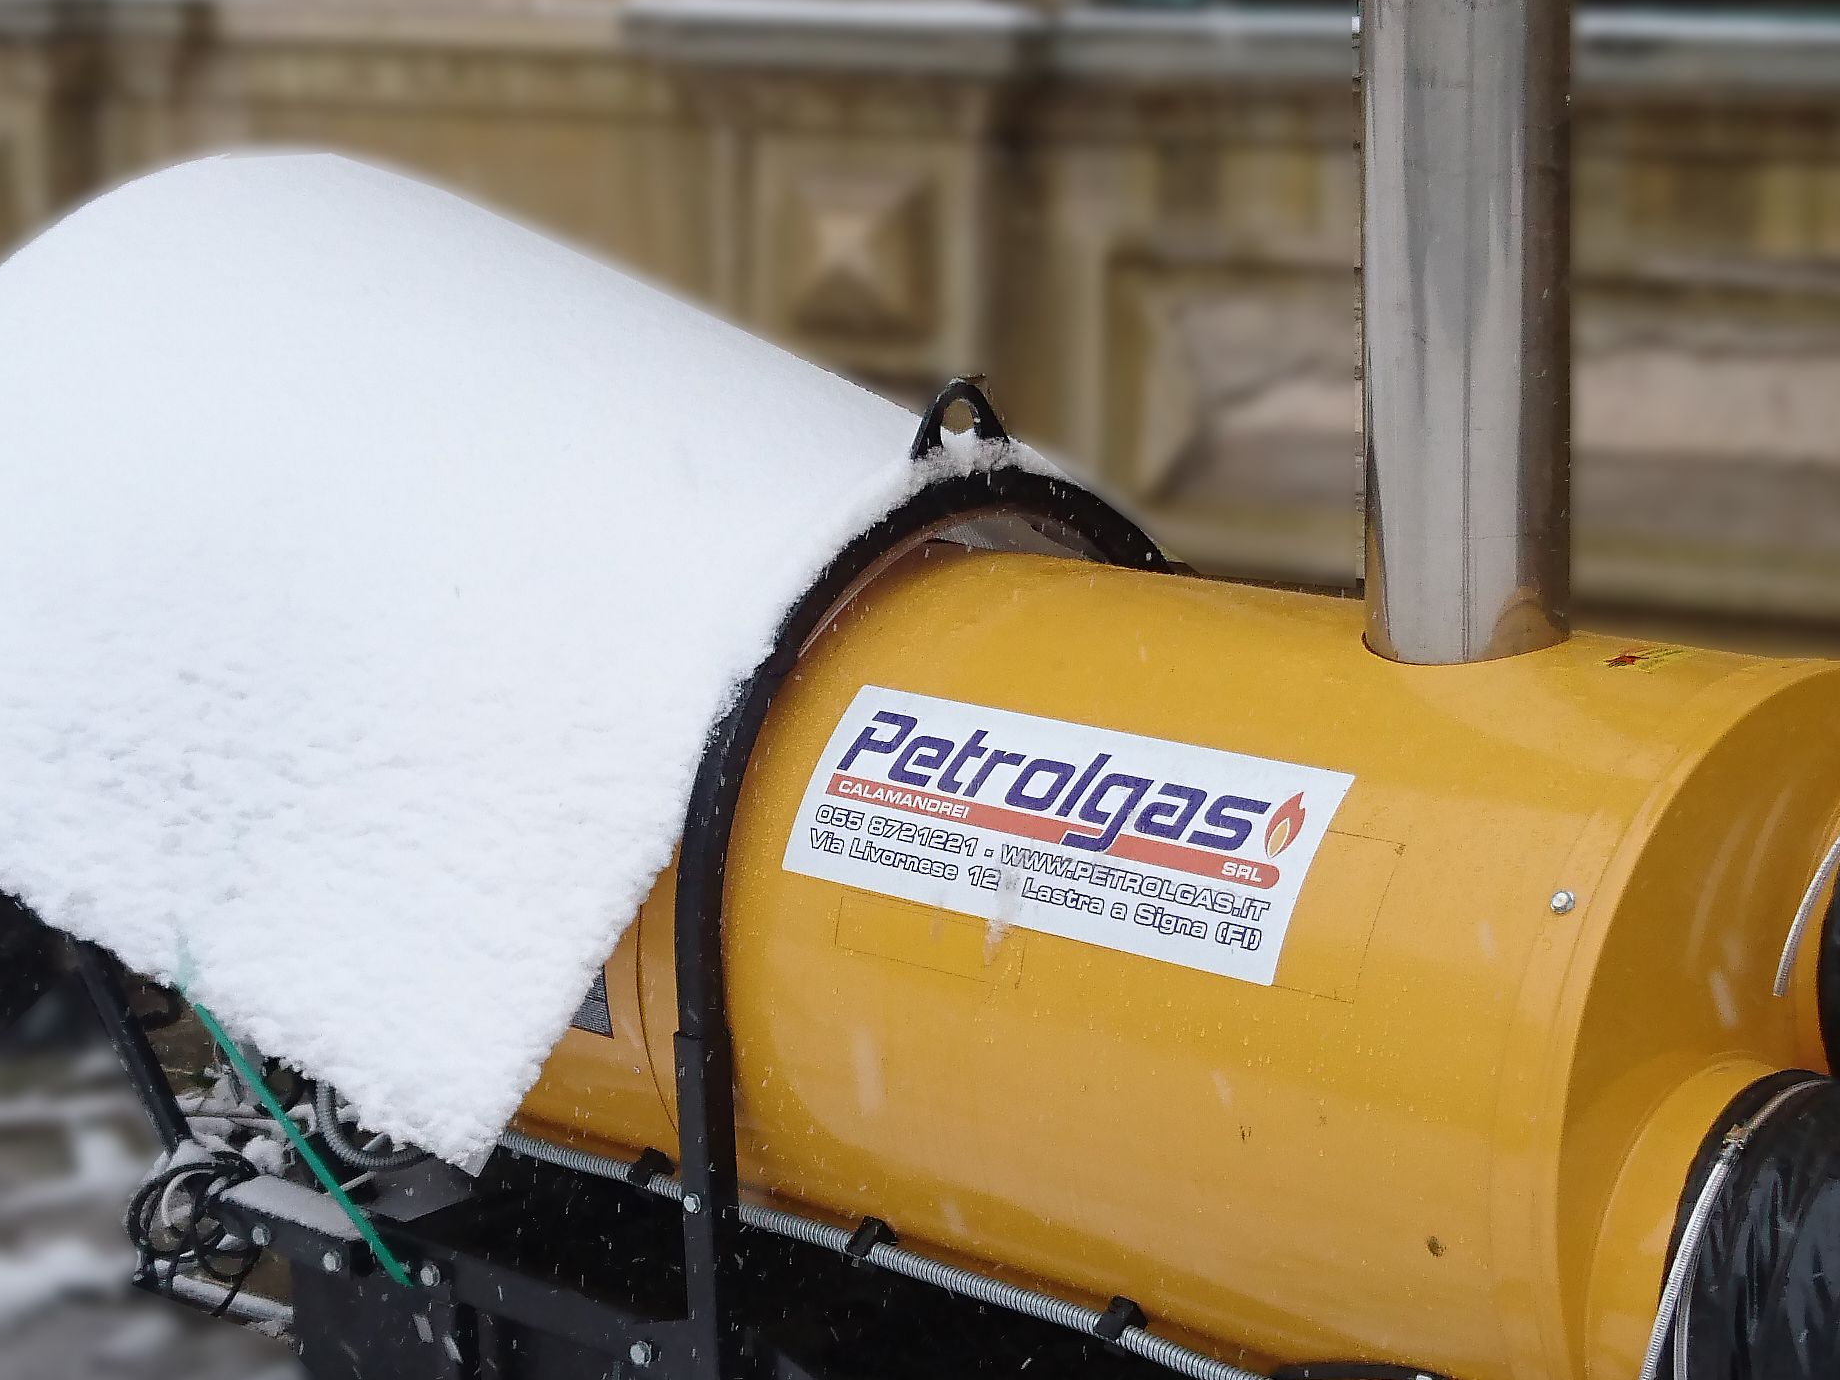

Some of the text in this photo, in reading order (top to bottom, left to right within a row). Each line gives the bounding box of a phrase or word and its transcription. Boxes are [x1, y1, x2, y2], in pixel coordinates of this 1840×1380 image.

[836, 710, 1272, 852] Petrolgas
[837, 779, 971, 820] CALAMANDREI
[810, 827, 846, 855] Via
[848, 837, 959, 881] Livornese
[1020, 876, 1105, 916] Lastra
[1109, 902, 1128, 921] a
[1133, 902, 1209, 940] Signa
[1214, 921, 1263, 952] (FI)
[815, 803, 1272, 923] 055 8721221 WWW.PETROLGAS.IT
[1220, 860, 1263, 884] SRL
